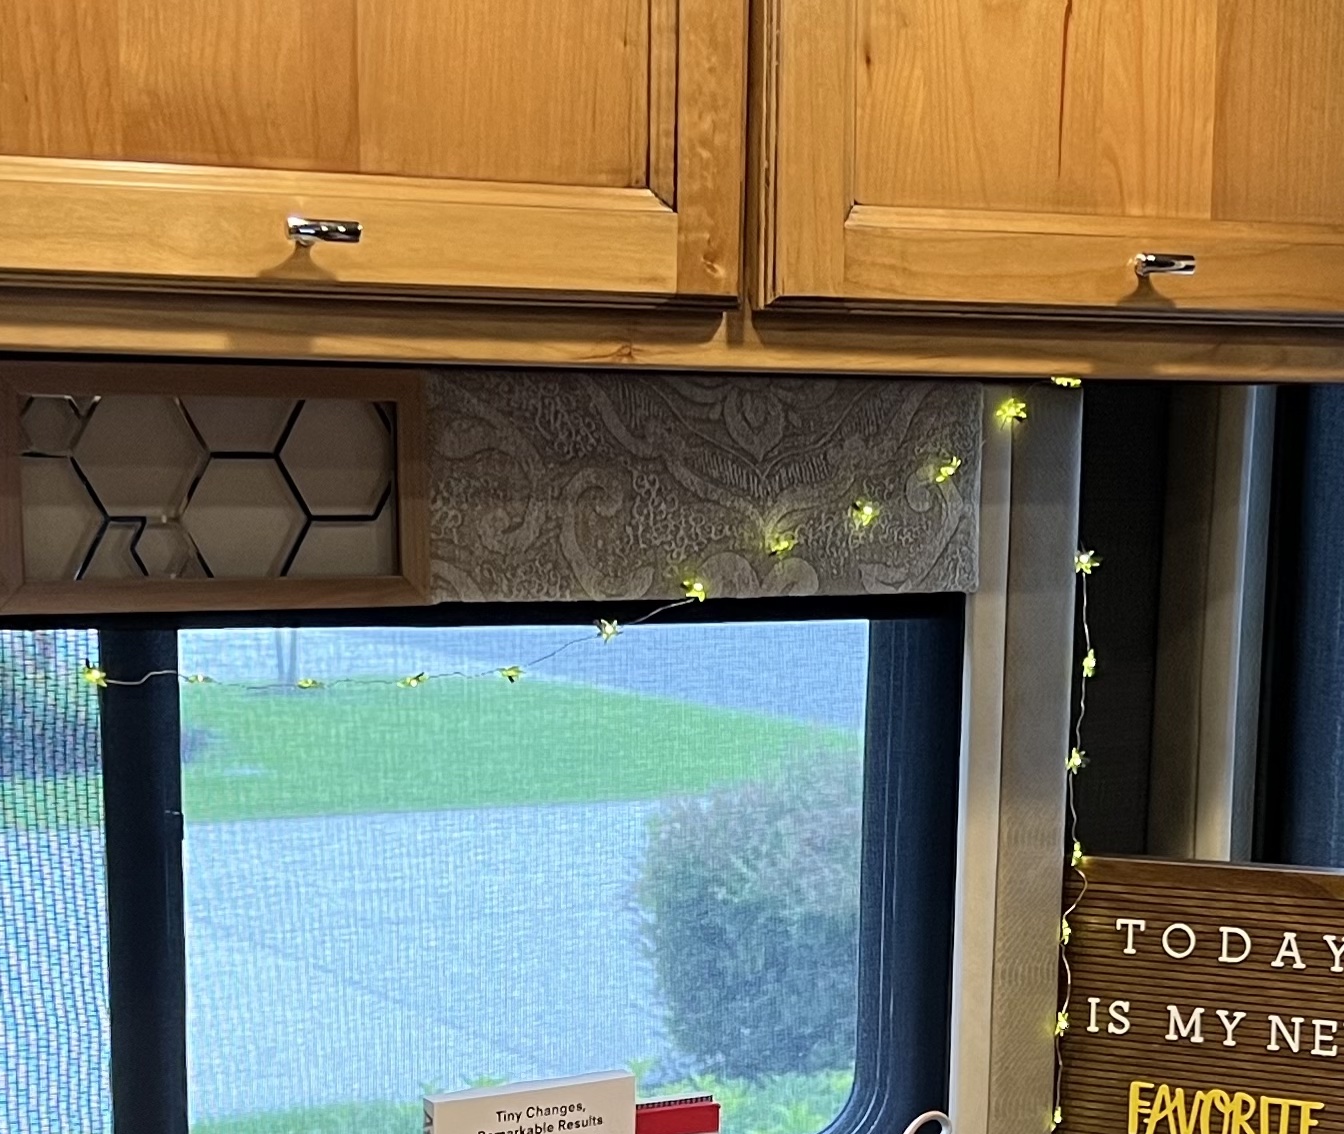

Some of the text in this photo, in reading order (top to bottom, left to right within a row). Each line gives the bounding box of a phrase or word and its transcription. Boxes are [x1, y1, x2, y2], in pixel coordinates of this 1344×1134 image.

[1086, 997, 1131, 1035] IS
[1164, 1004, 1247, 1047] MY
[495, 1101, 587, 1124] Tiny Changes,
[558, 1115, 604, 1131] Results
